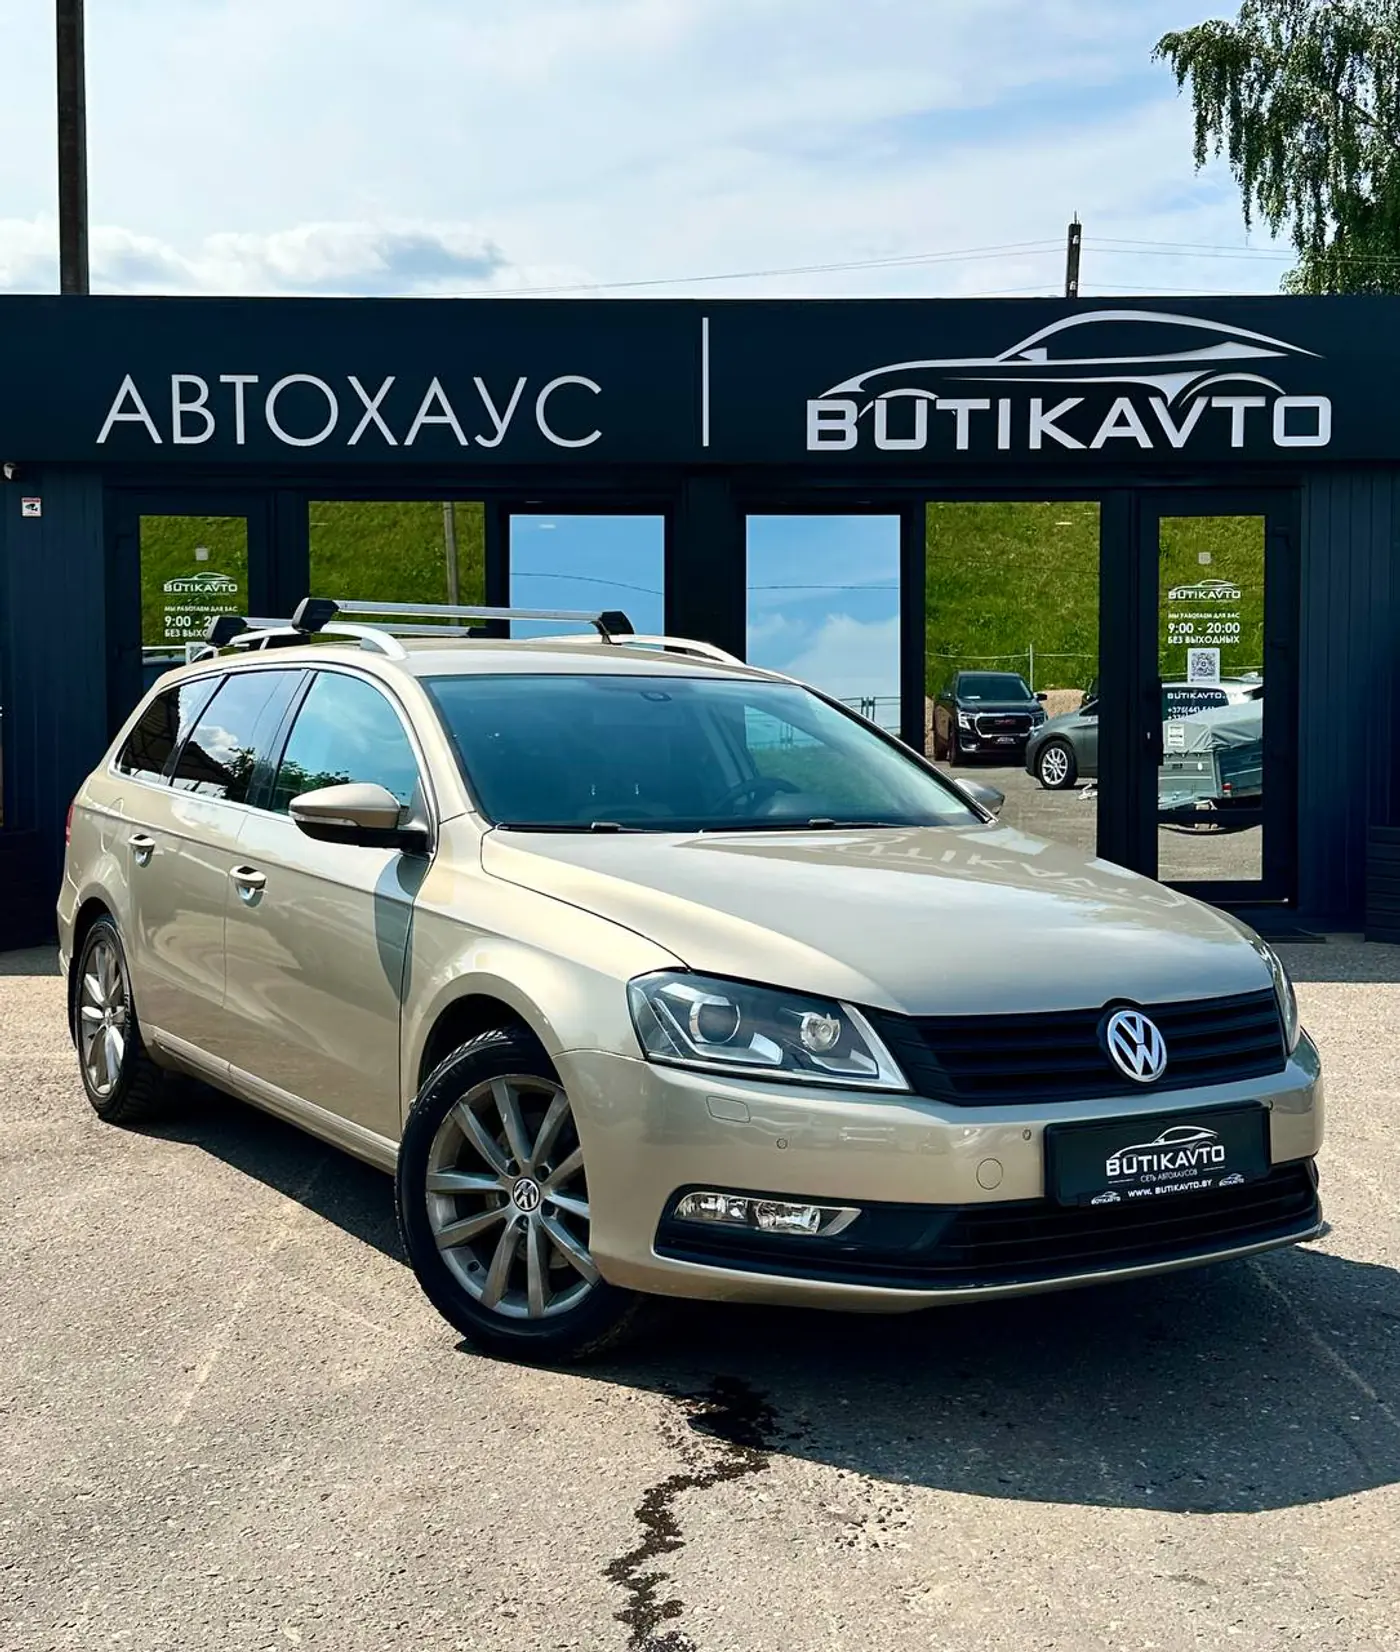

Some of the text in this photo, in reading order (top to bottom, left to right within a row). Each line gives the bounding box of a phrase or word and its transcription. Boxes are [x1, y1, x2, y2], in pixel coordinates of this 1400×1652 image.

[96, 374, 603, 448] АВТОХАУС
[806, 395, 1332, 451] BUTIKAVTO
[163, 583, 238, 592] BUTIKAVTO
[1168, 590, 1241, 599] BUTIKAVTO
[164, 616, 191, 627] 9:00
[164, 629, 180, 638] БЕЗ
[1168, 622, 1194, 634] 9:00
[1206, 622, 1241, 634] 20:00
[1168, 636, 1240, 645] БЕЗ ВЫХОДНЫХ
[1106, 1145, 1225, 1177] BUTIKAVTO
